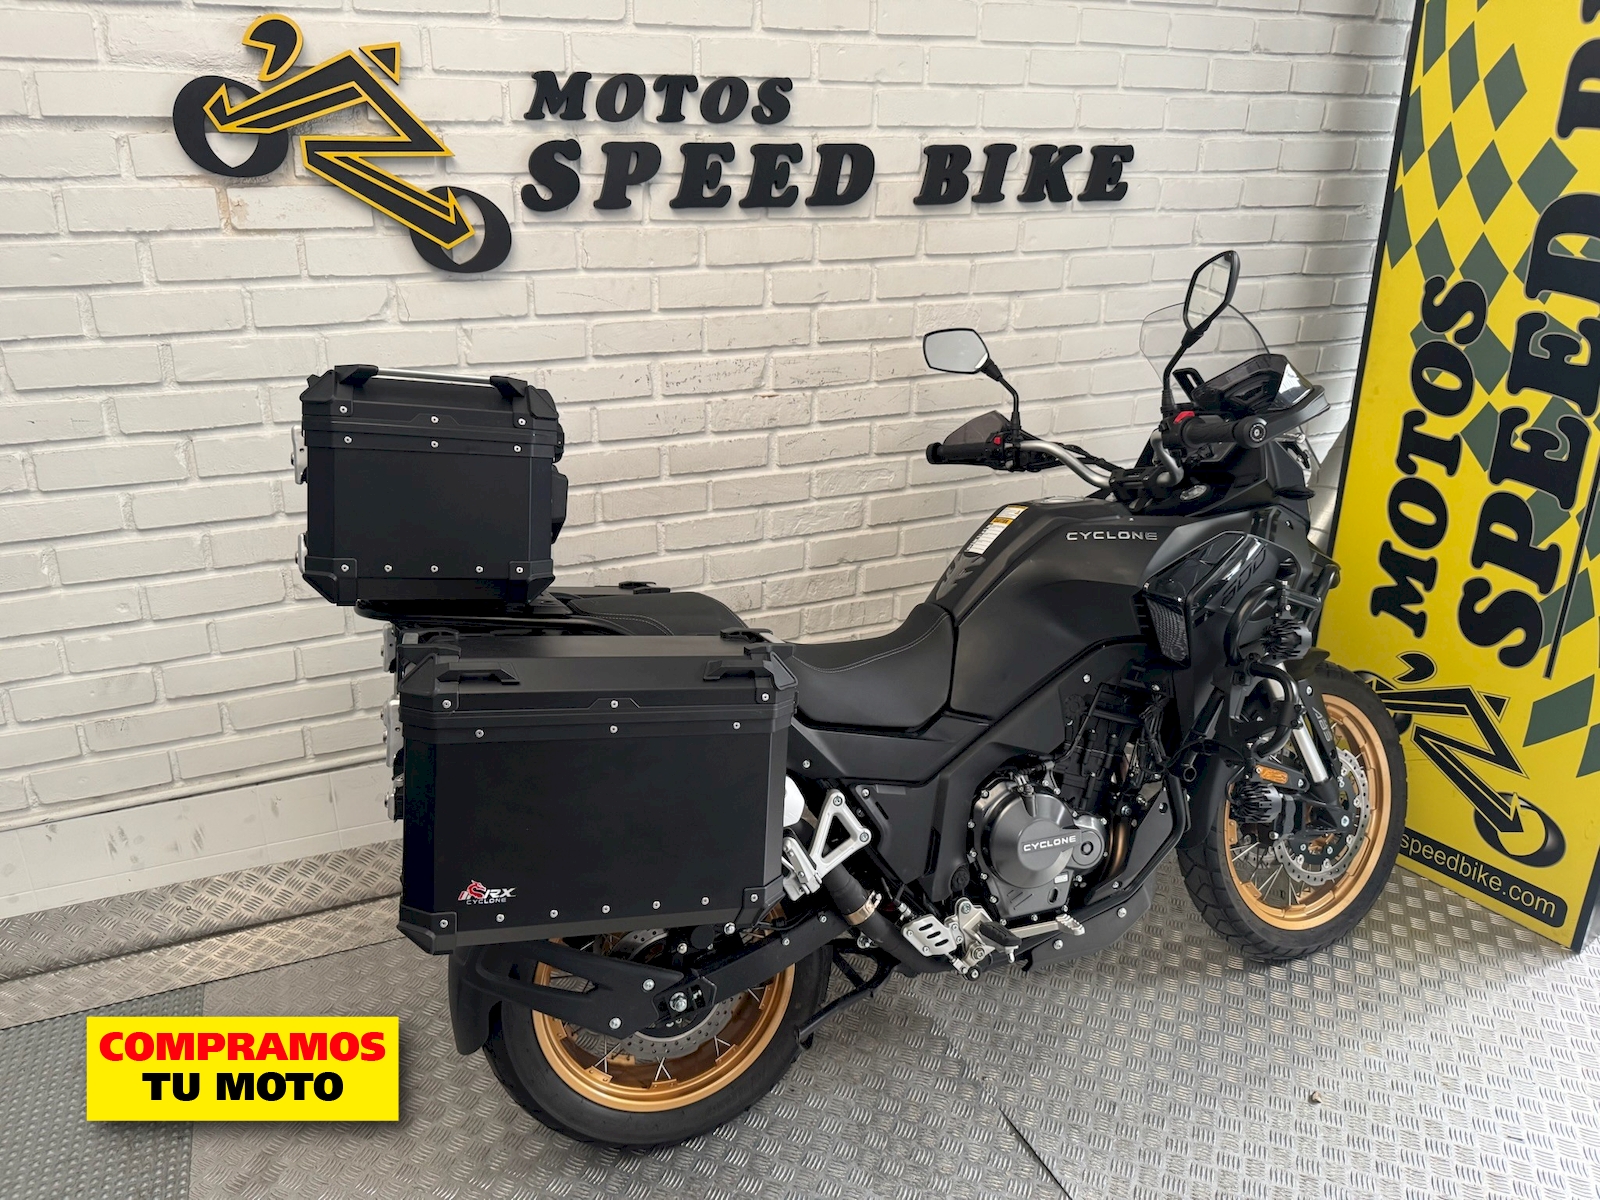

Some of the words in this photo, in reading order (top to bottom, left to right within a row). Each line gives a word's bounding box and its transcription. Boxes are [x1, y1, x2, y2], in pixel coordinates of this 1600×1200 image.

[523, 70, 793, 125] MOTOS
[520, 139, 876, 211] SPEED
[913, 143, 1135, 206] BIKE
[1370, 275, 1488, 638] MOTOS
[1457, 193, 1600, 669] SPEED
[1066, 530, 1158, 541] CYCLONE
[1023, 835, 1077, 852] CYCLONE
[466, 897, 507, 905] CYCLONE
[1400, 833, 1556, 918] speedbike.com
